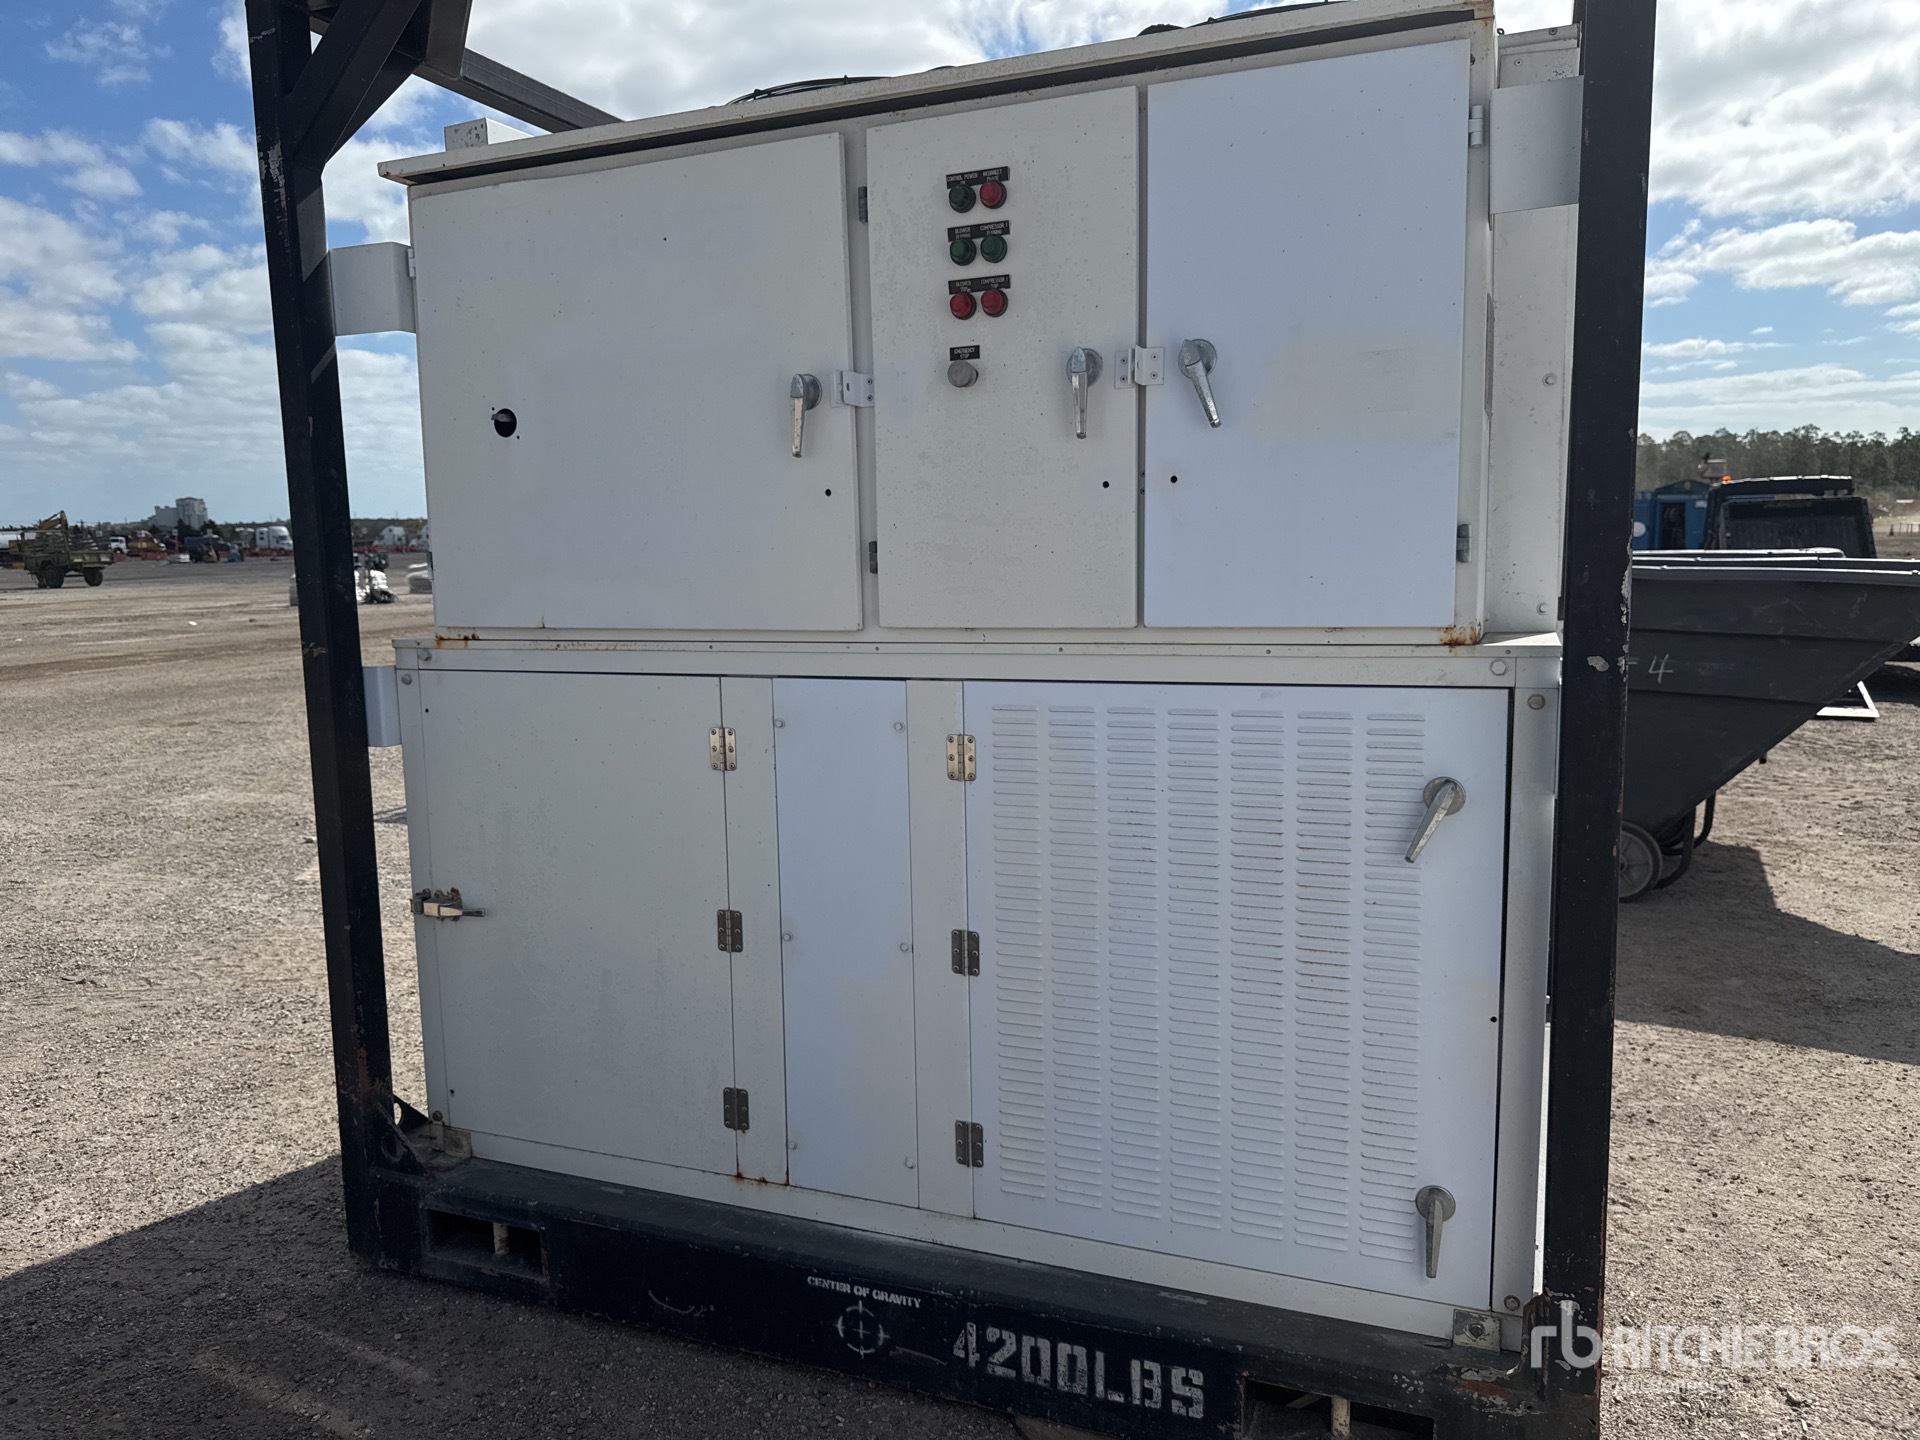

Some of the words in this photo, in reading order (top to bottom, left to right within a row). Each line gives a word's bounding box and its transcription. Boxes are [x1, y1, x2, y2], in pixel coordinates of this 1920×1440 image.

[964, 172, 979, 180] POWER
[954, 226, 971, 234] BLOWER
[980, 222, 1005, 231] COMPRESSOR
[953, 347, 976, 355] EMERGENCY
[1648, 653, 1674, 685] 4
[807, 1275, 851, 1294] CENTER
[853, 1285, 870, 1297] OF
[872, 1289, 921, 1308] GRAVITY
[953, 1322, 1204, 1419] 4200LBS
